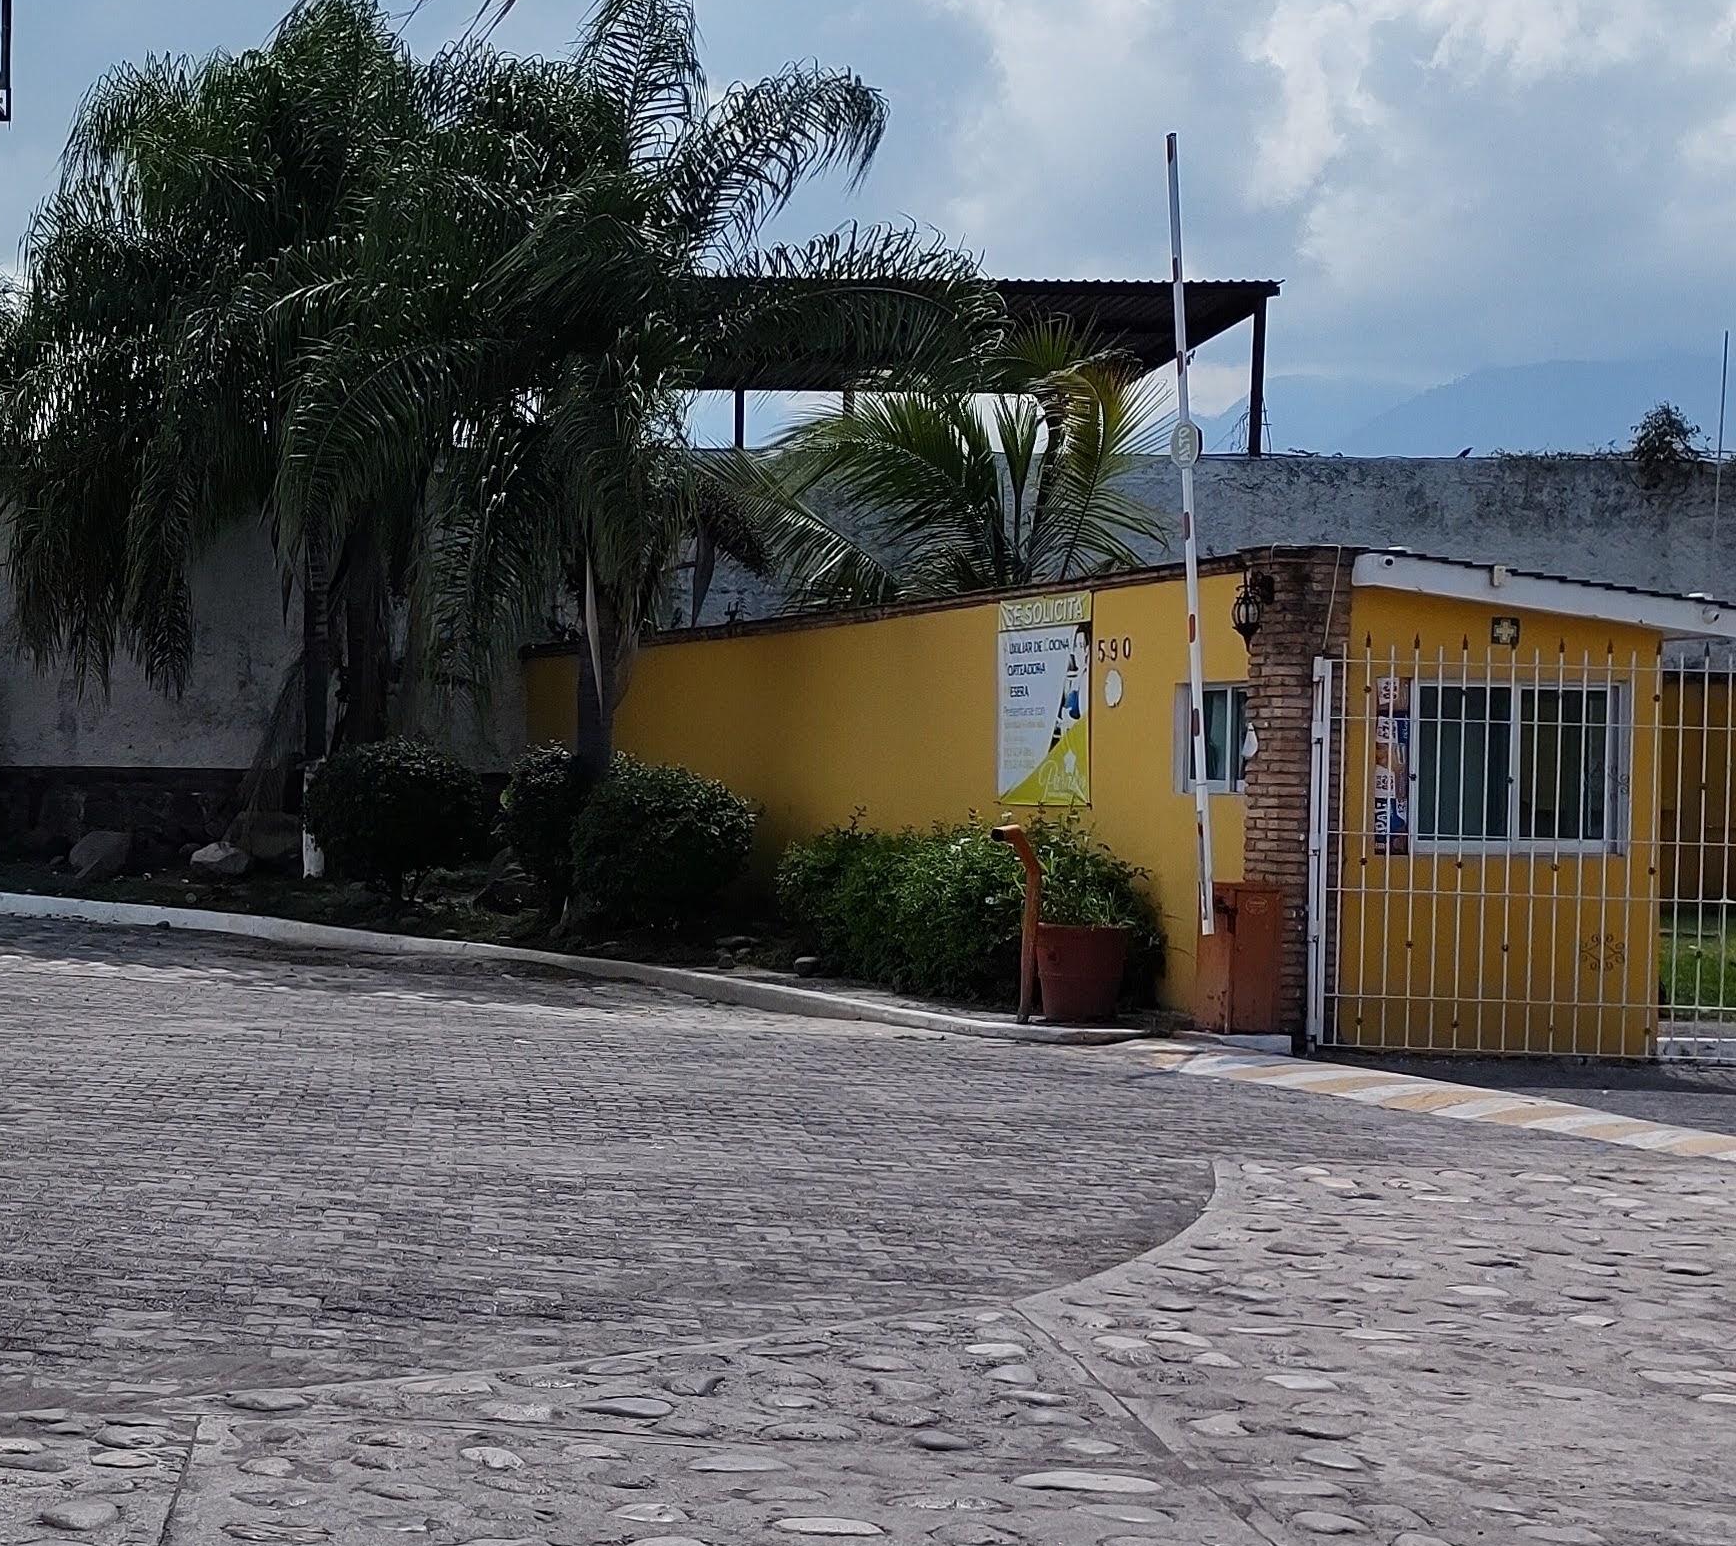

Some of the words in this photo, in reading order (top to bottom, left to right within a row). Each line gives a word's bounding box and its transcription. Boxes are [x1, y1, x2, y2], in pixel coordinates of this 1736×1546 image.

[1005, 604, 1023, 627] SE
[1024, 596, 1084, 626] SOLICITA
[1033, 640, 1043, 652] DE
[1097, 636, 1132, 662] 590
[1005, 663, 1046, 676] ORTEADORA
